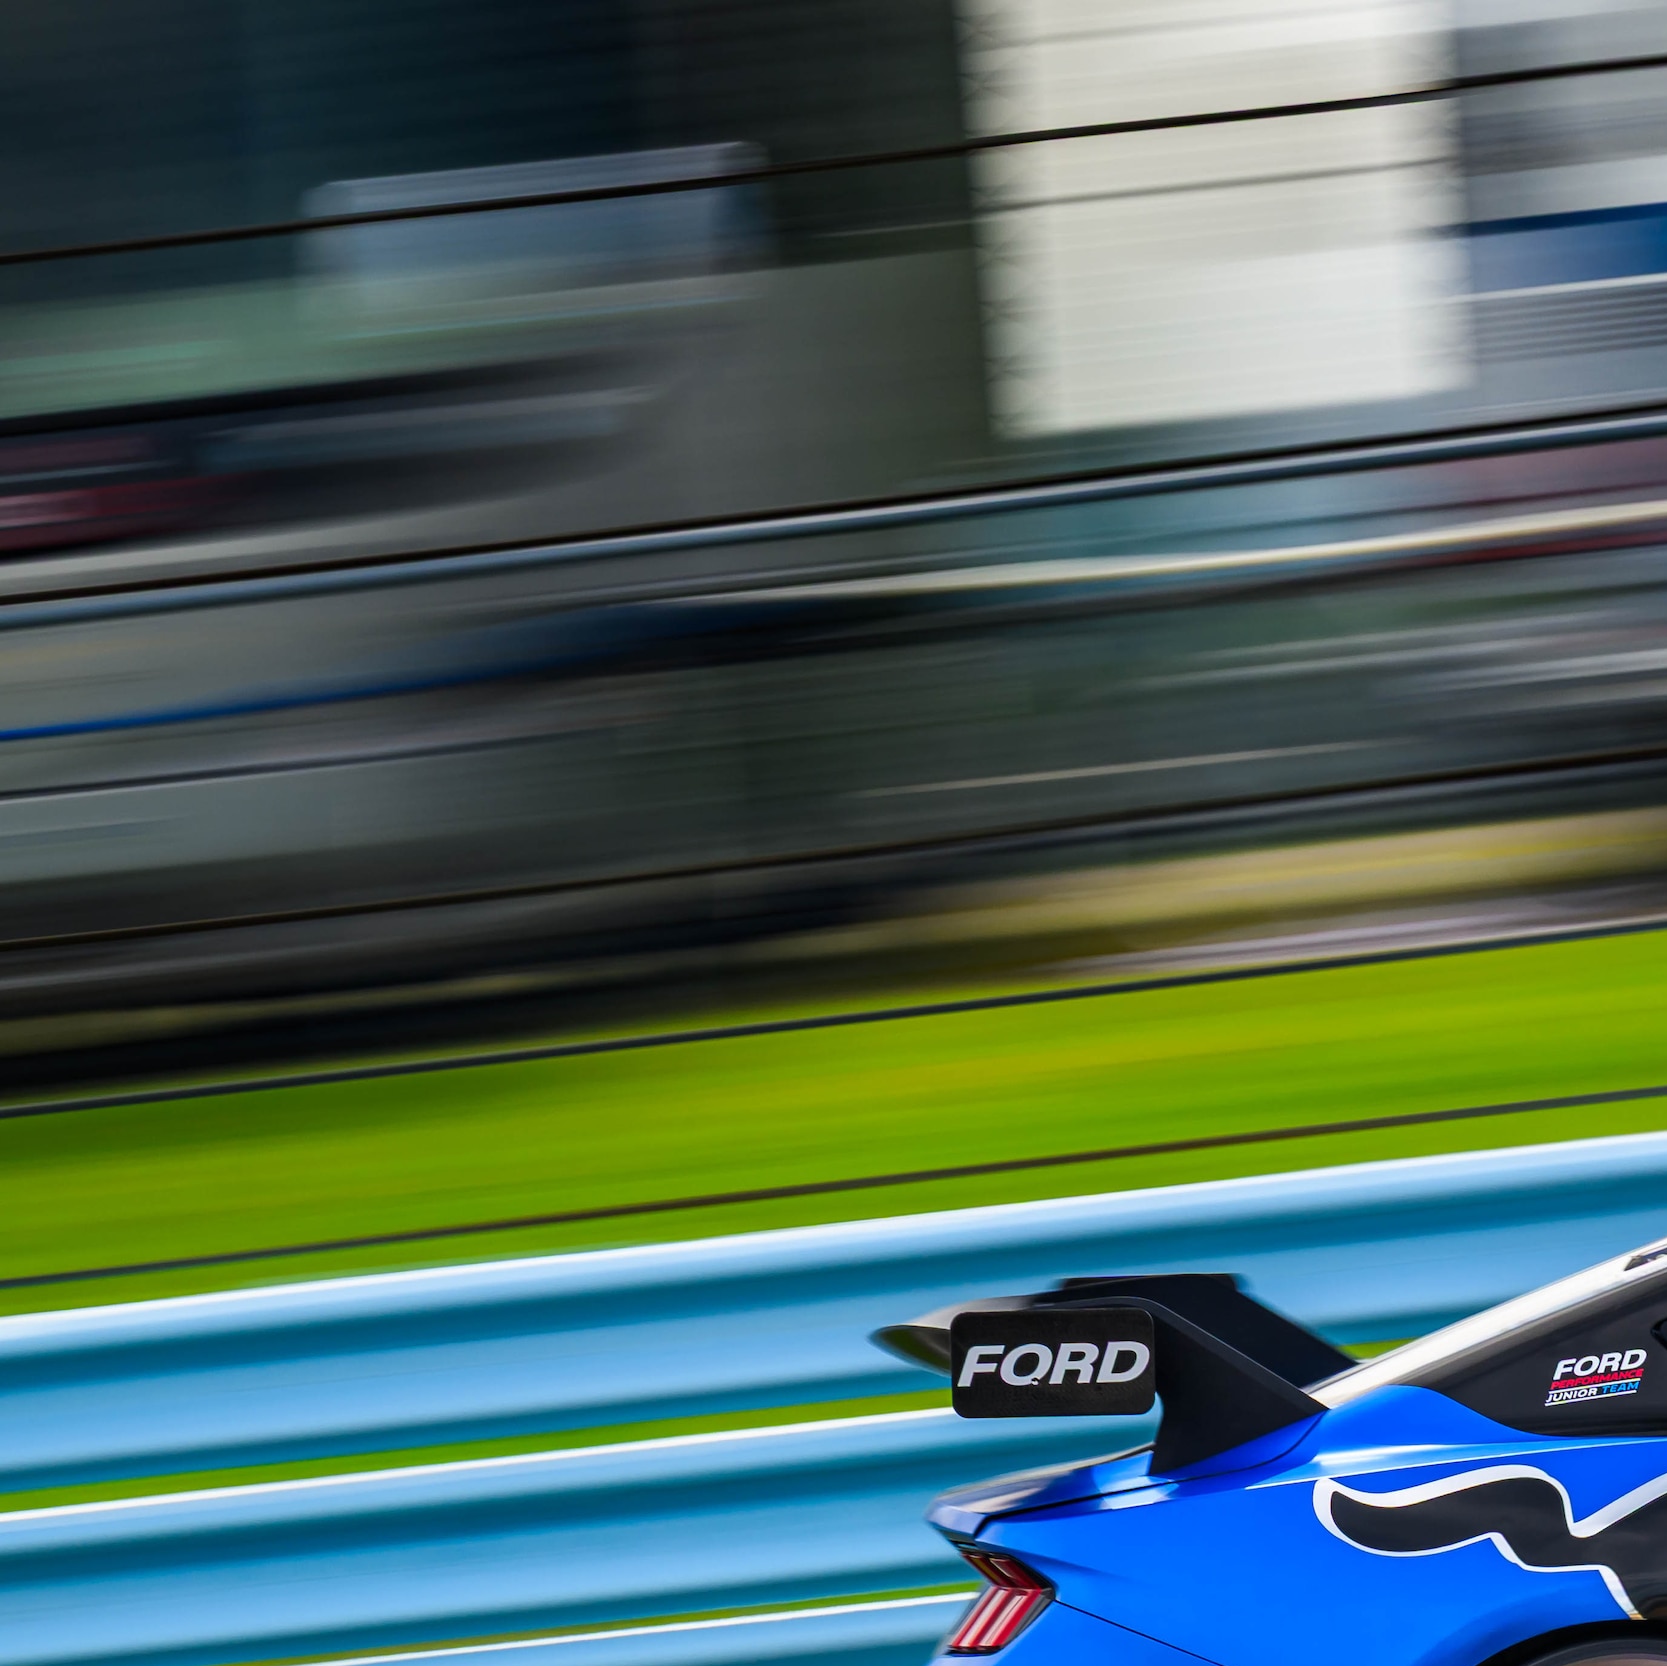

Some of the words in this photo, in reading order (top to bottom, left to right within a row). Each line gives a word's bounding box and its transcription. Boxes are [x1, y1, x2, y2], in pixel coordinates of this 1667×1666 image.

[957, 1340, 1150, 1388] FORD
[1553, 1349, 1647, 1380] FORD
[1546, 1387, 1598, 1402] JUNIOR
[1602, 1381, 1640, 1394] TEAM
[1550, 1369, 1644, 1390] PERFORMANCE
